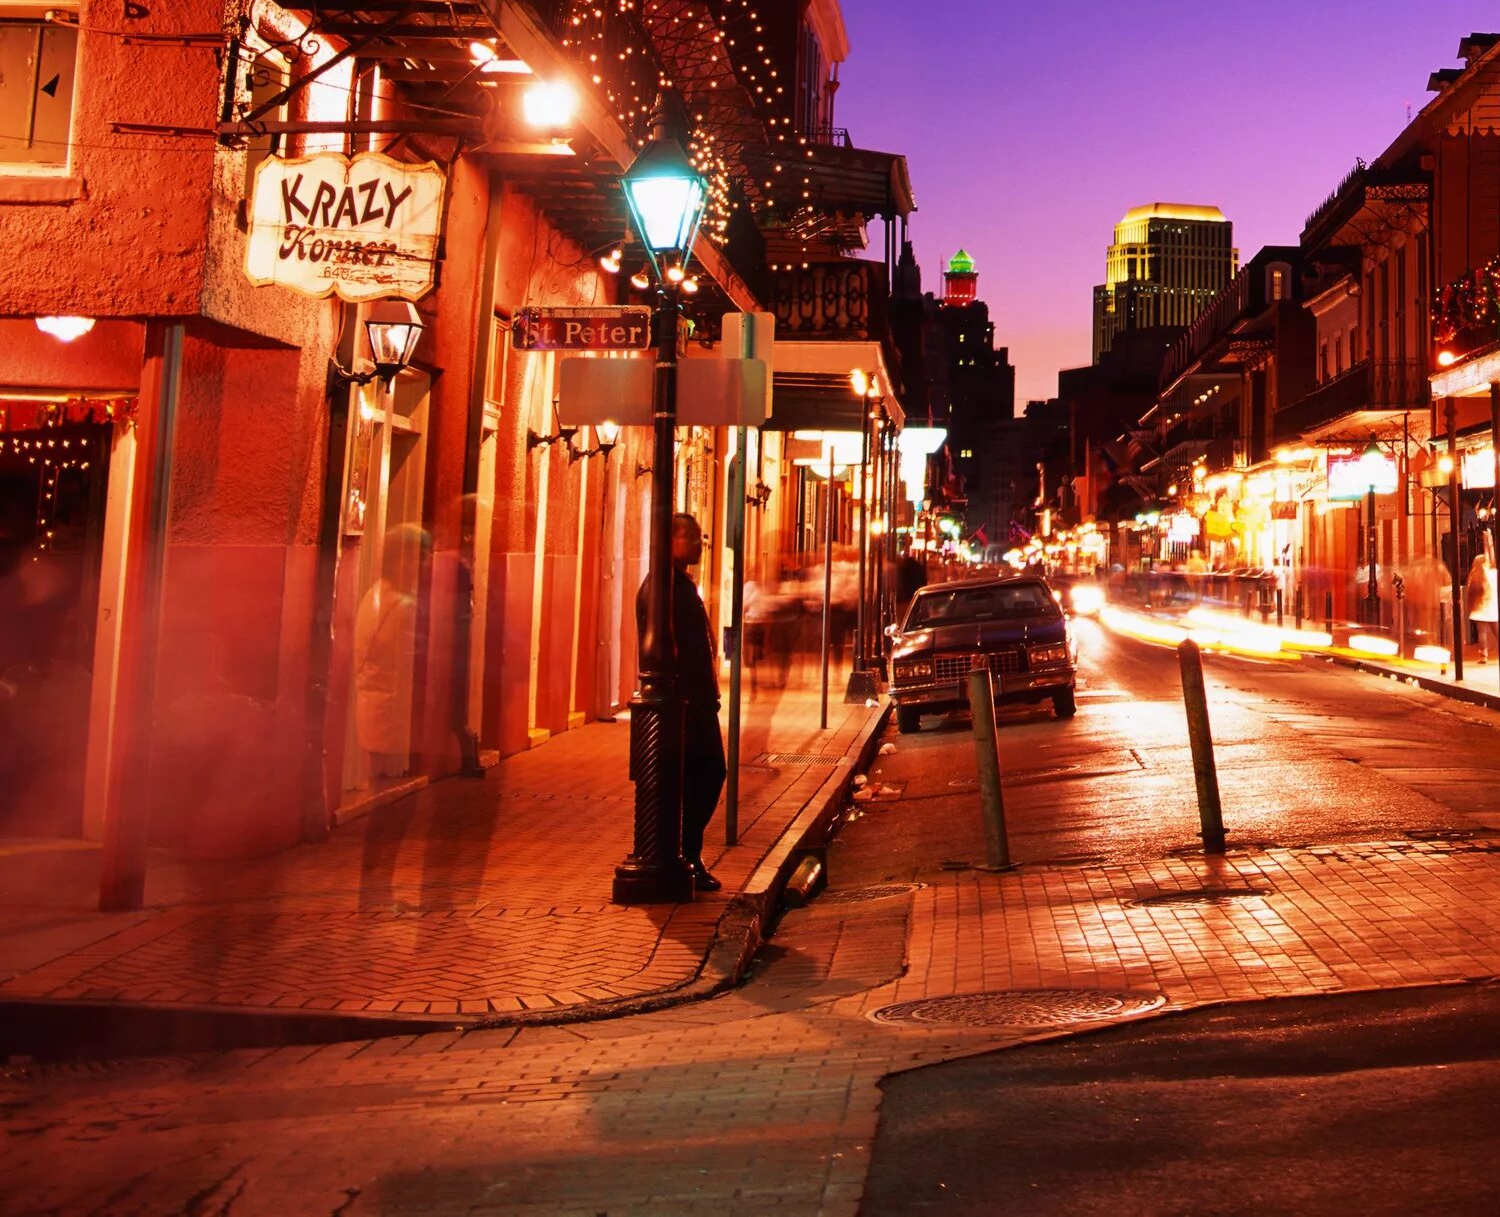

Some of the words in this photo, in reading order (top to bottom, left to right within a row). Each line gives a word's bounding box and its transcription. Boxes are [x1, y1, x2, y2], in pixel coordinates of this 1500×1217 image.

[281, 173, 413, 229] KRAZY
[279, 224, 398, 267] Korner
[523, 321, 556, 345] St.
[565, 322, 642, 345] Peter
